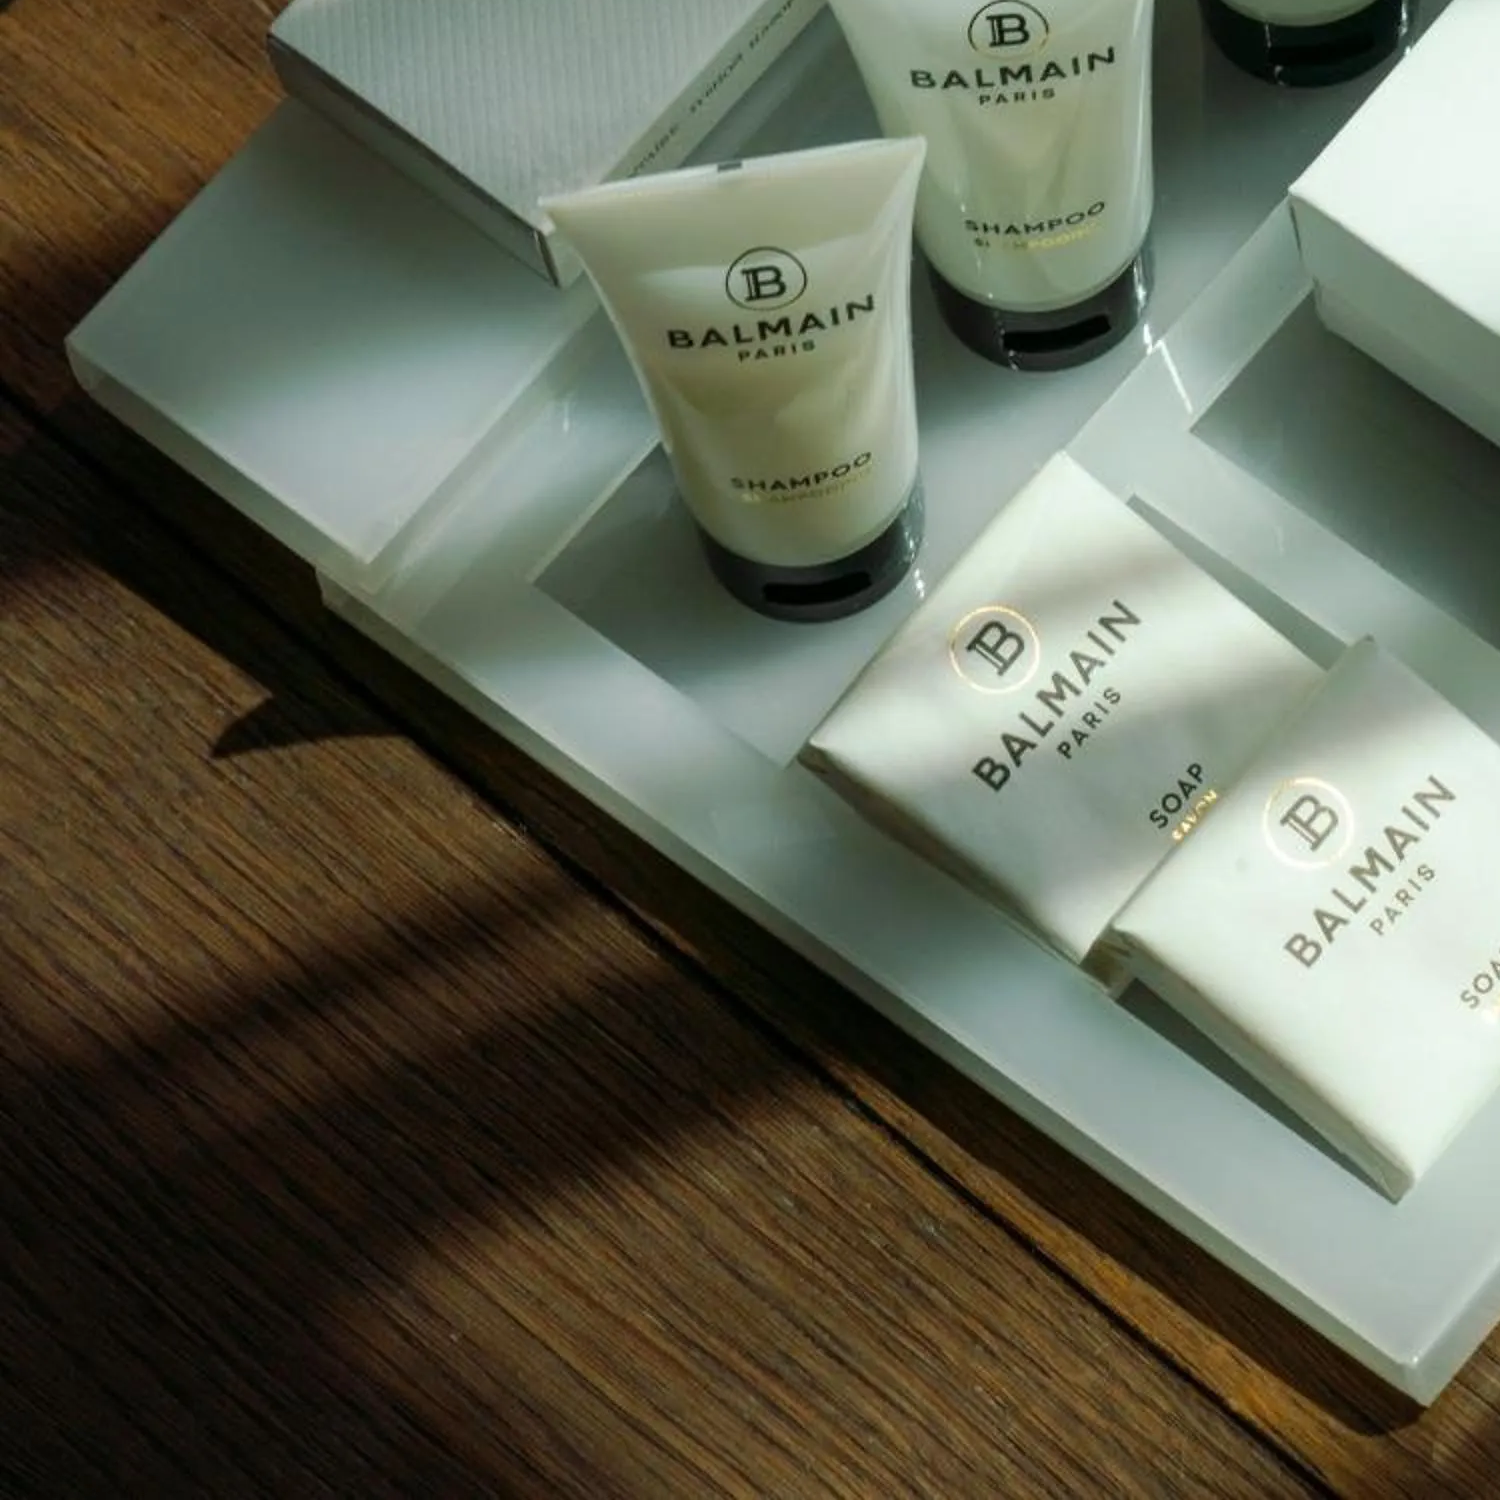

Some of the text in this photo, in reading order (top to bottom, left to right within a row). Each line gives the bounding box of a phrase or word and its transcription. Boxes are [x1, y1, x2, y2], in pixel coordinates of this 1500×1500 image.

[910, 45, 1116, 90] BALMAIN
[978, 87, 1056, 106] PARIS
[964, 201, 1106, 235] SHAMPOO
[666, 294, 875, 349] BALMAIN
[738, 339, 816, 363] PARIS
[730, 452, 872, 491] SHAMPOO
[971, 598, 1142, 793] BALMAIN
[1056, 686, 1122, 760] PARIS
[1149, 762, 1204, 830] SOAP
[1283, 774, 1457, 969] BALMAIN
[1369, 863, 1437, 937] PARIS
